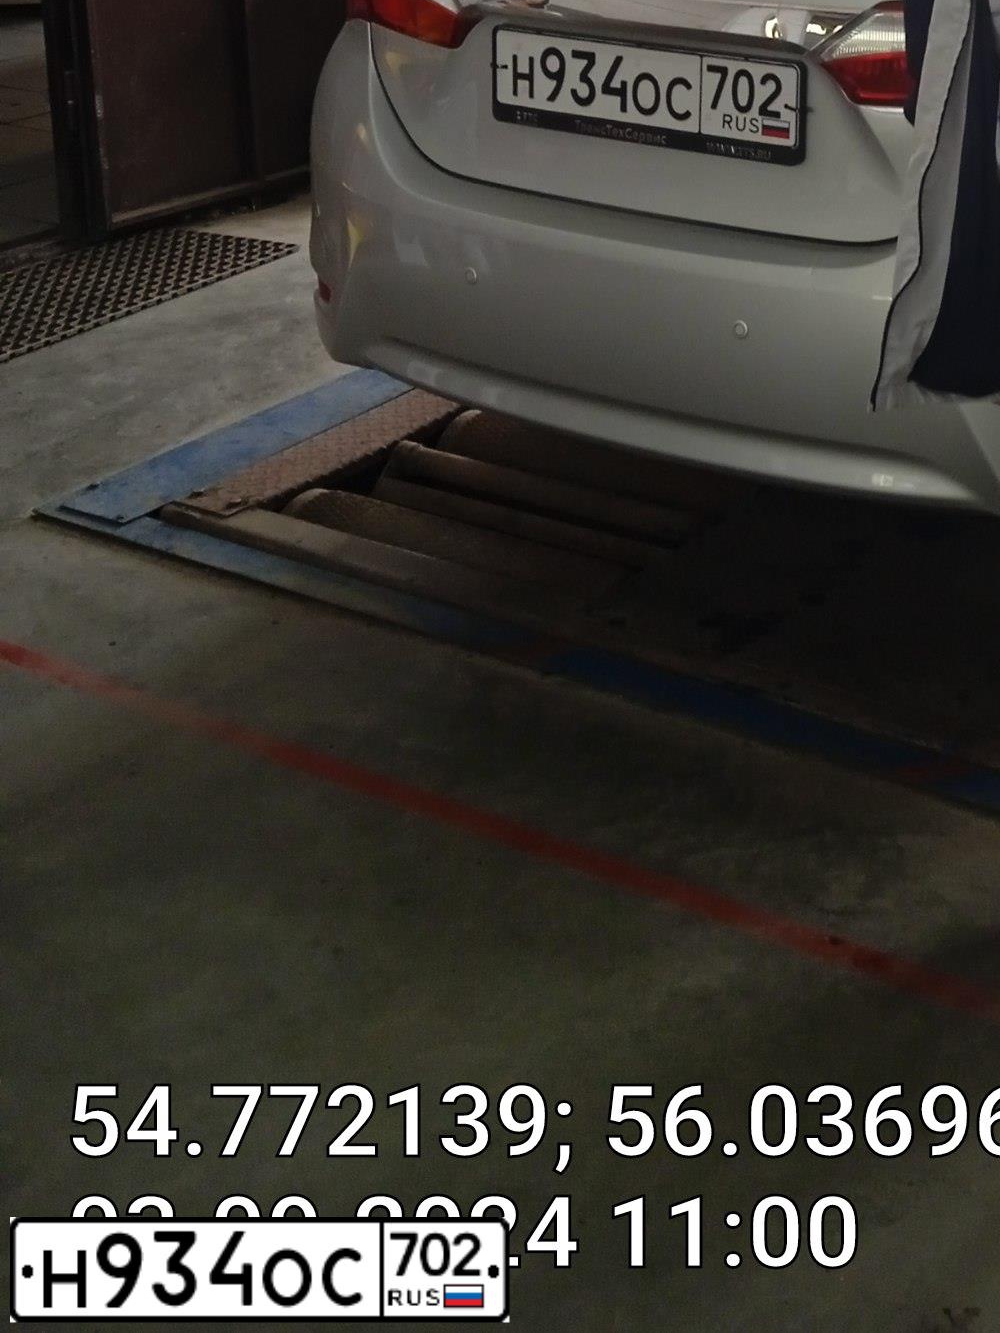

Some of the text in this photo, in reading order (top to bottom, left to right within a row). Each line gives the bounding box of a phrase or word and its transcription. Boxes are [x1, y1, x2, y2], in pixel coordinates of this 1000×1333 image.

[512, 46, 781, 121] Н934ОС 702
[722, 114, 759, 133] RUS
